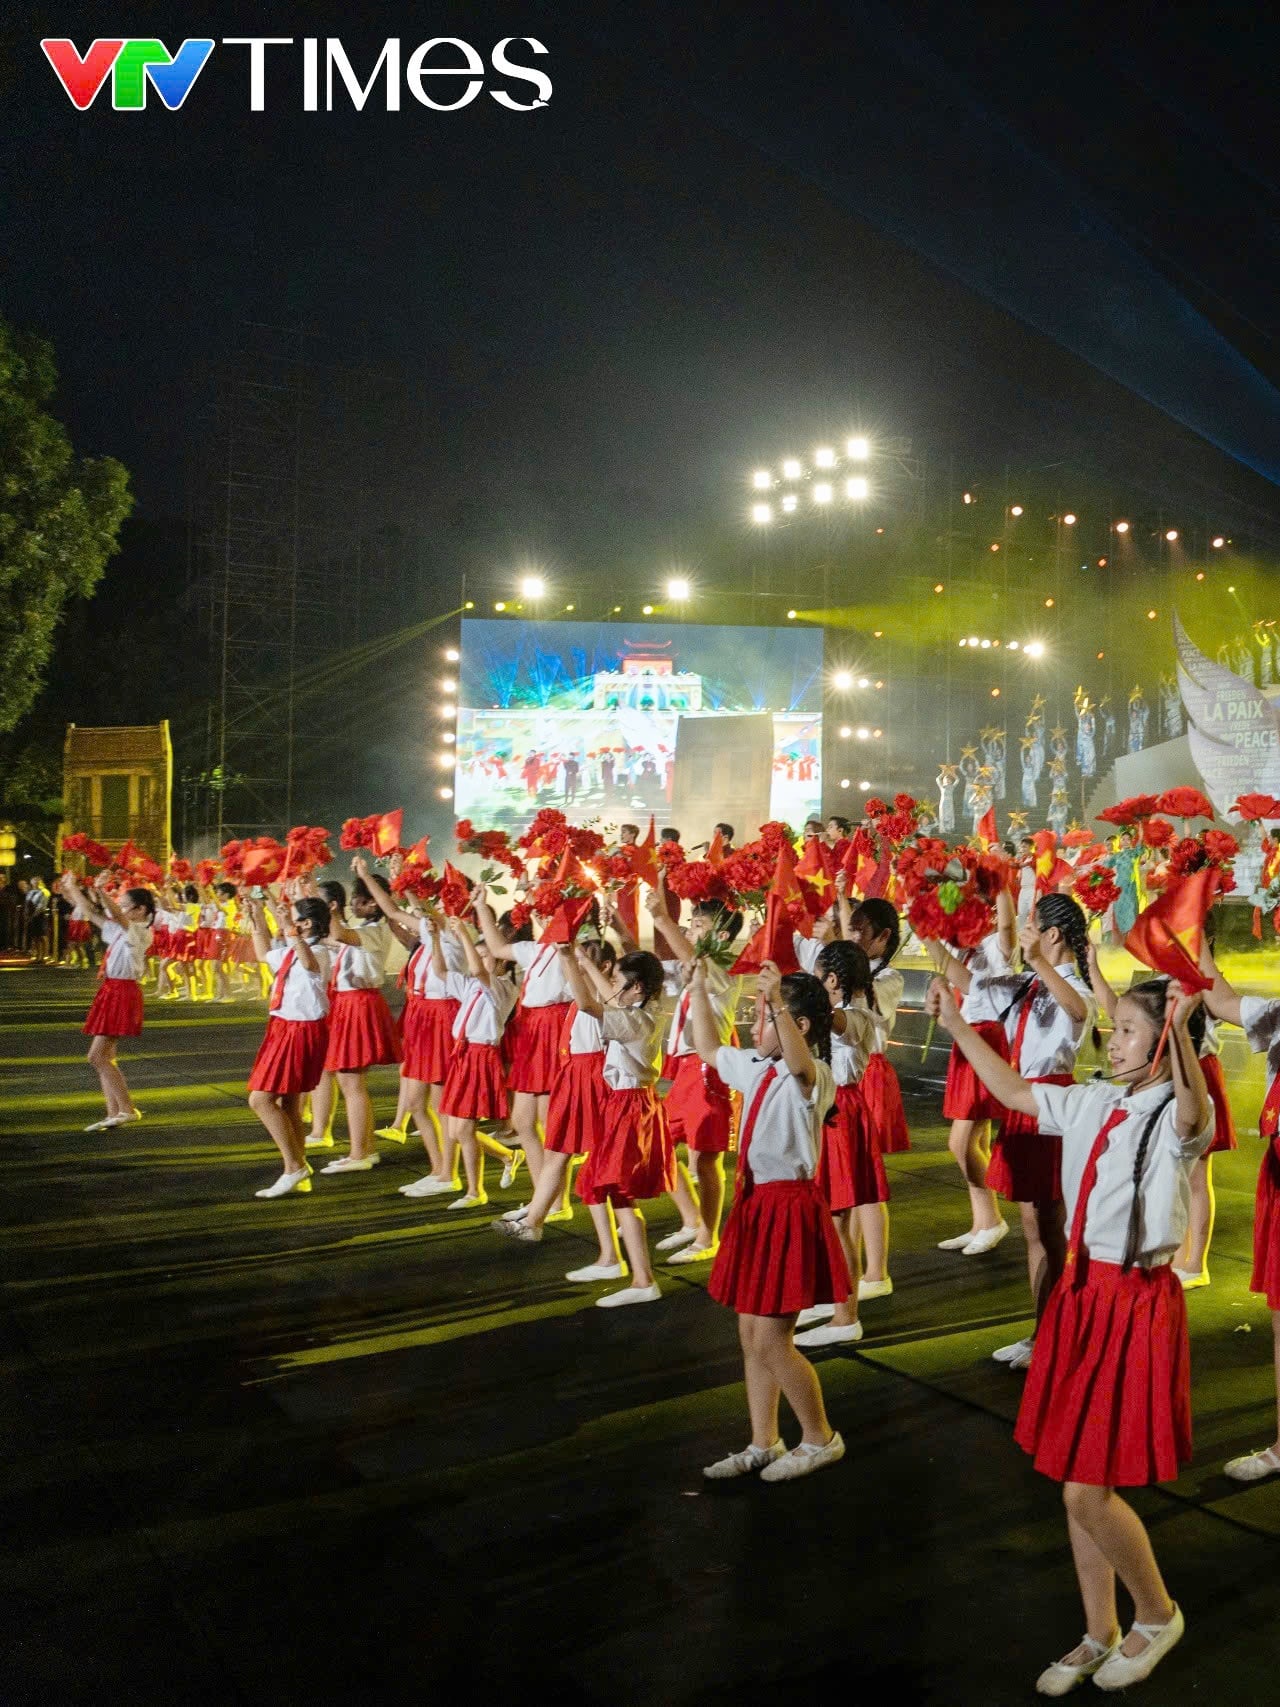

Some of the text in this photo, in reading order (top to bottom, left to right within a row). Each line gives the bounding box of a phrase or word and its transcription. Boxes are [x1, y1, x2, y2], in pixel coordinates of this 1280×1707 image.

[1203, 700, 1264, 721] LA PAIX
[1235, 730, 1278, 749] PEACE
